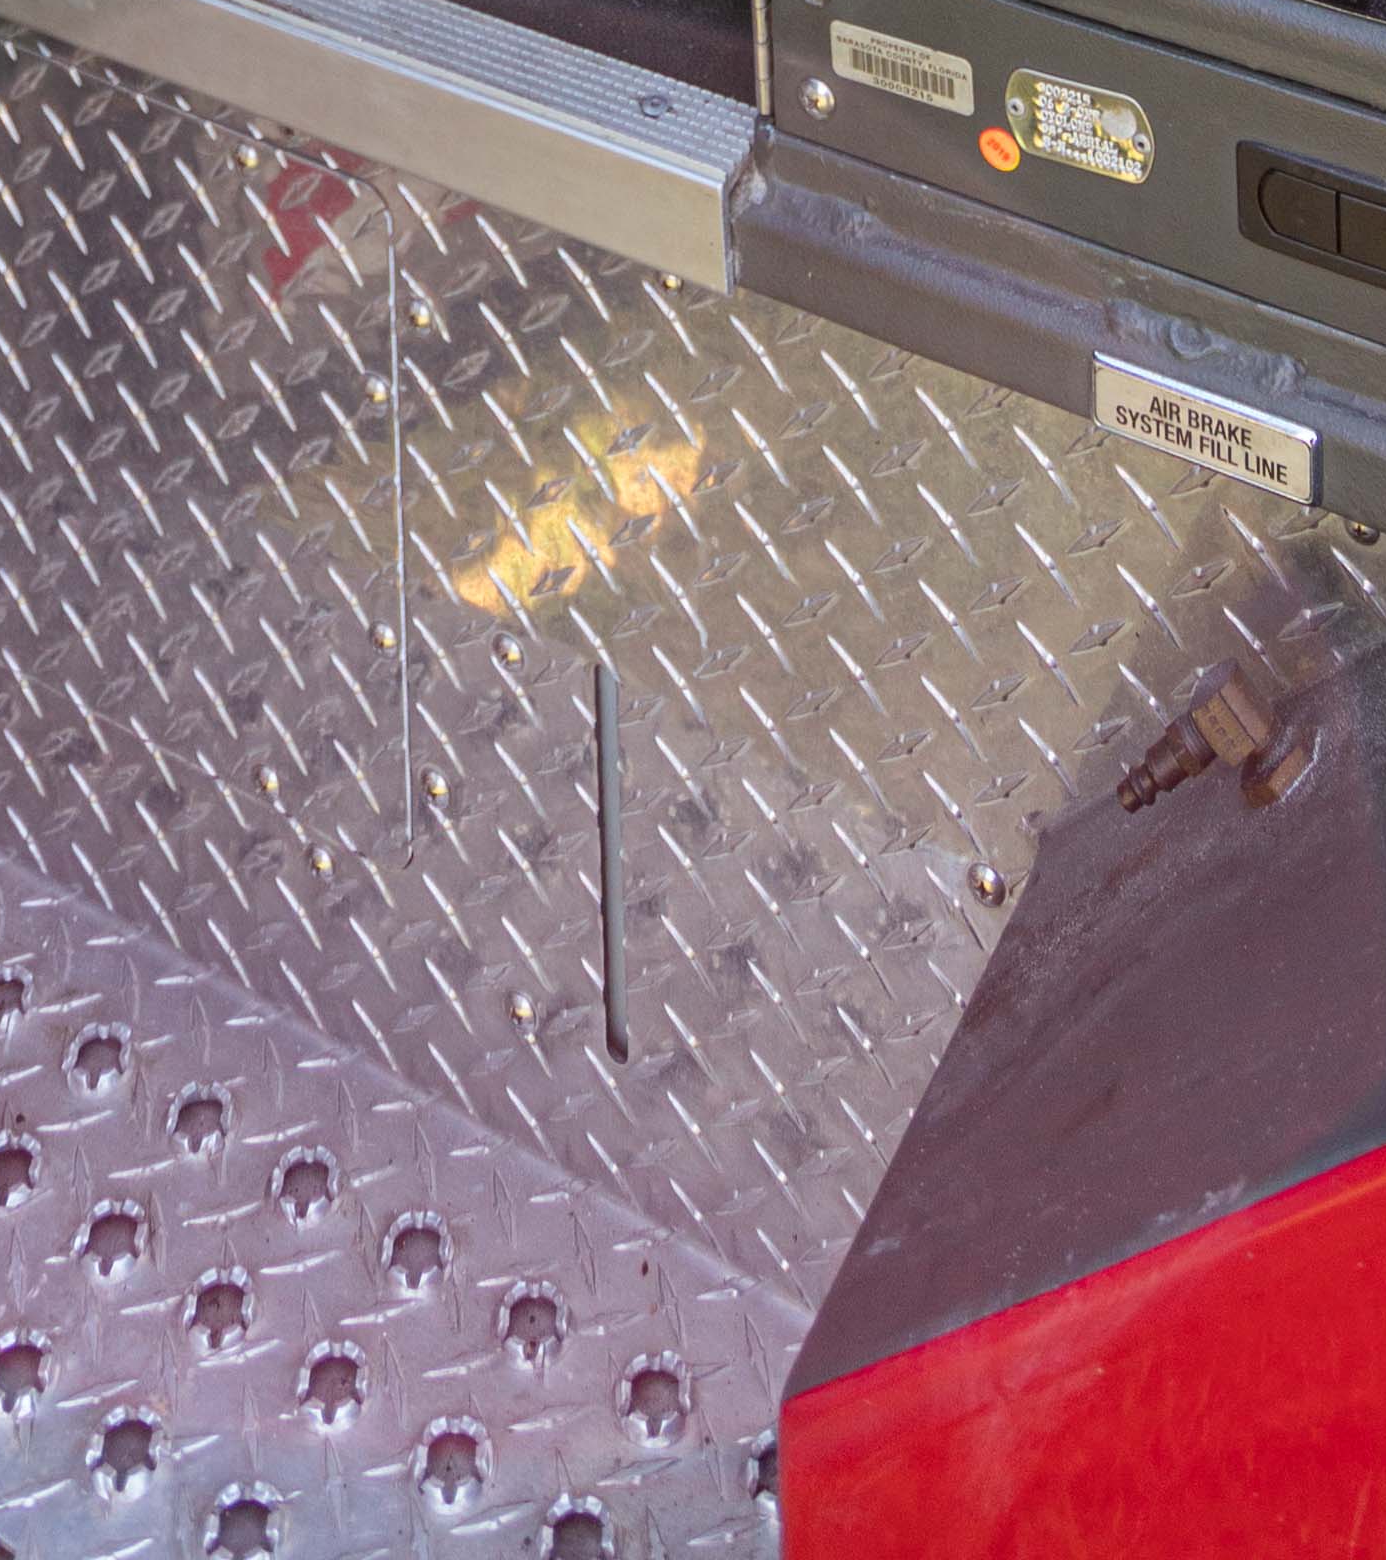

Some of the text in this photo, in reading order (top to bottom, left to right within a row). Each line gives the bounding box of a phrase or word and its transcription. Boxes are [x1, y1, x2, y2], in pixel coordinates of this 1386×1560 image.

[1115, 405, 1288, 484] SYSTEM FILL LINE
[1149, 396, 1252, 450] AIR BRAKE
